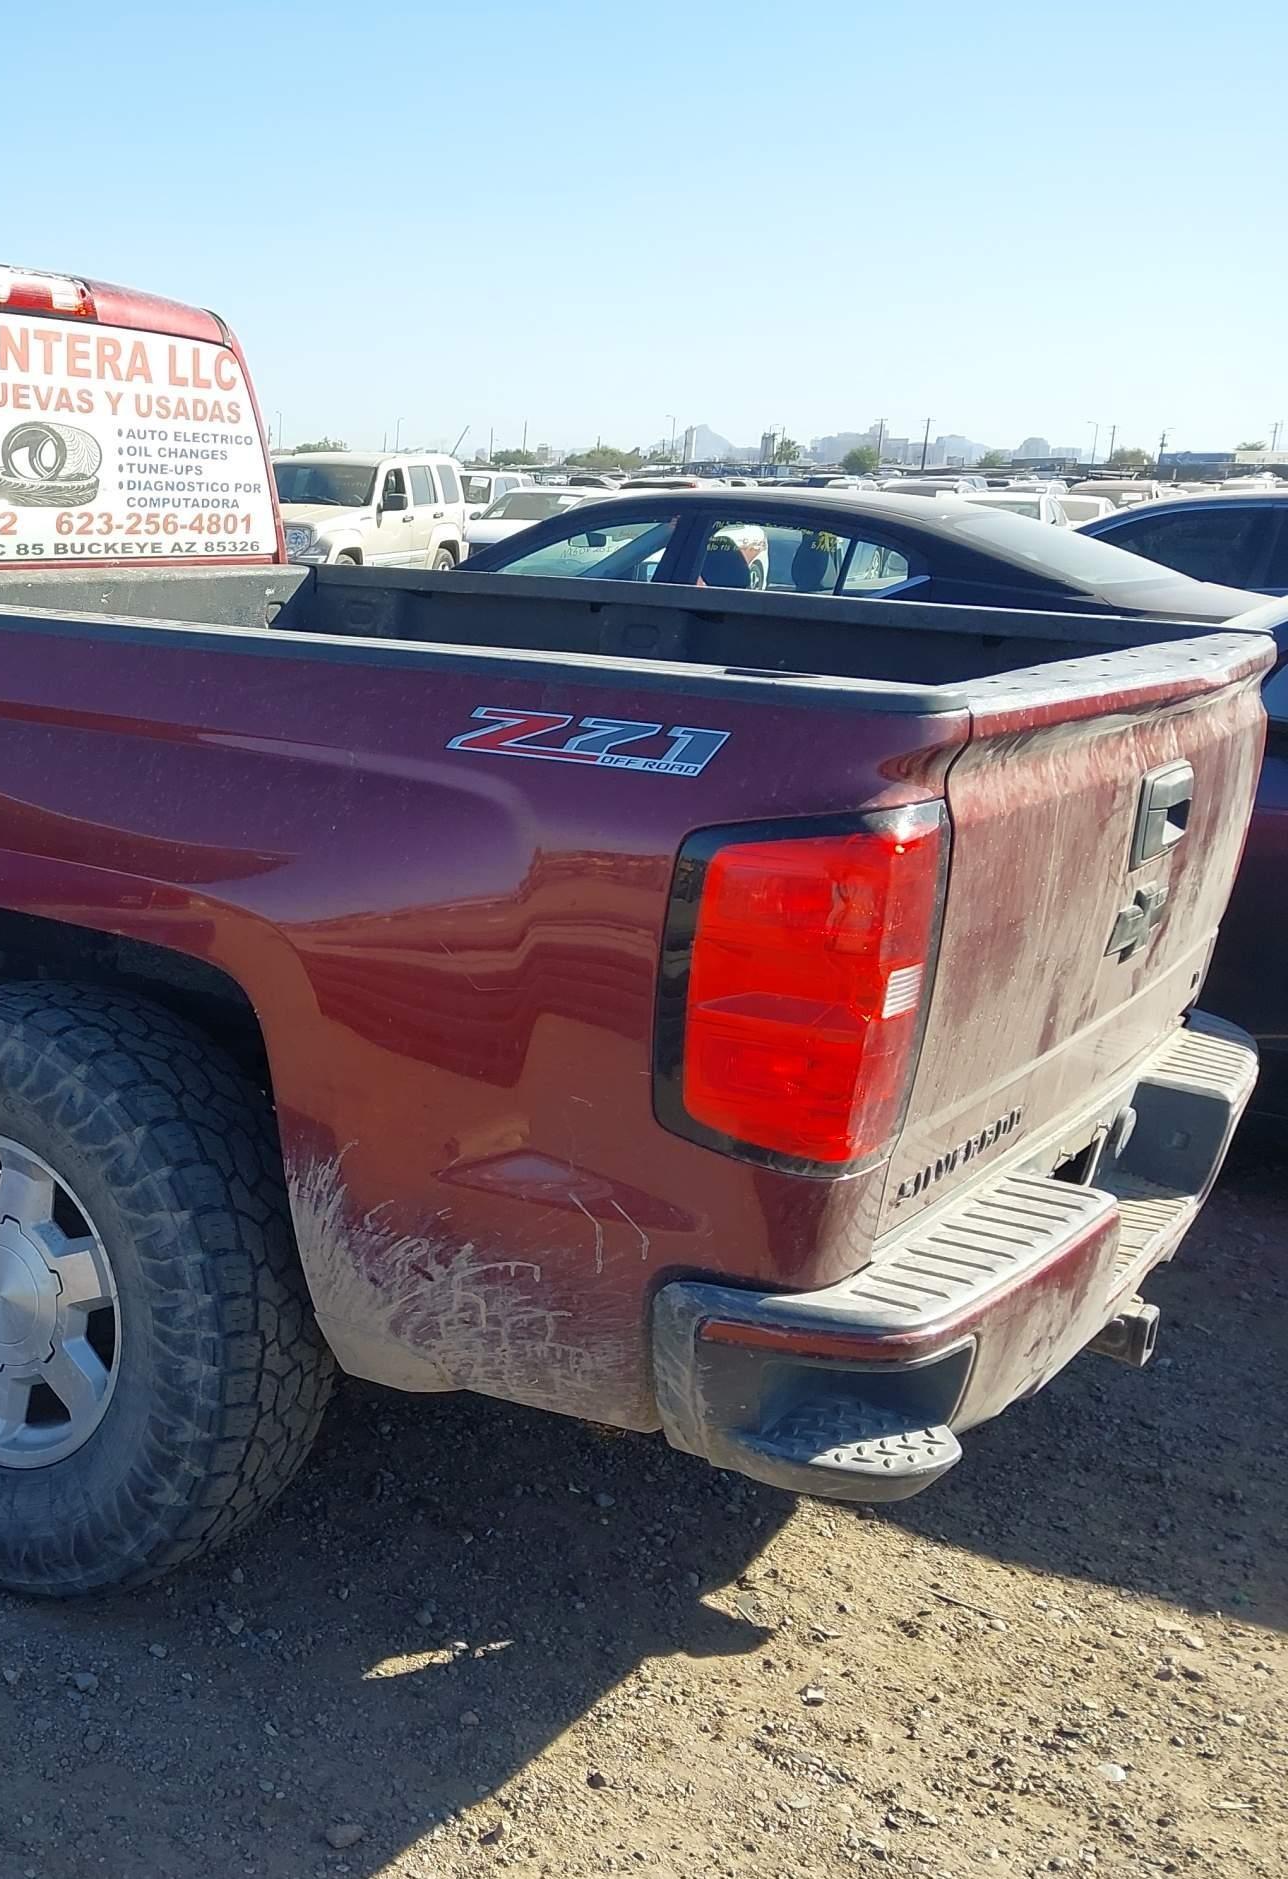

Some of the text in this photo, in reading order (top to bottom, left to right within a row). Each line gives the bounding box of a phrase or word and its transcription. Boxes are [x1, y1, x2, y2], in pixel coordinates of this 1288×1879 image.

[168, 344, 237, 391] LLC
[105, 390, 124, 416] Y
[135, 393, 241, 424] USADAS
[126, 429, 254, 446] AUTO ELECTRICO
[126, 446, 228, 461] OIL CHANGES
[127, 463, 203, 476] TUNE-UPS
[126, 480, 262, 494] DIAGNOSTICO POR
[126, 496, 240, 510] COMPUTADORA
[55, 511, 253, 536] 623-256-4801
[15, 543, 45, 557] 85
[54, 541, 163, 556] BUCKEYE
[170, 541, 198, 554] AZ
[204, 540, 261, 553] 85326
[446, 705, 732, 766] Z71
[600, 755, 699, 775] OFF ROAD
